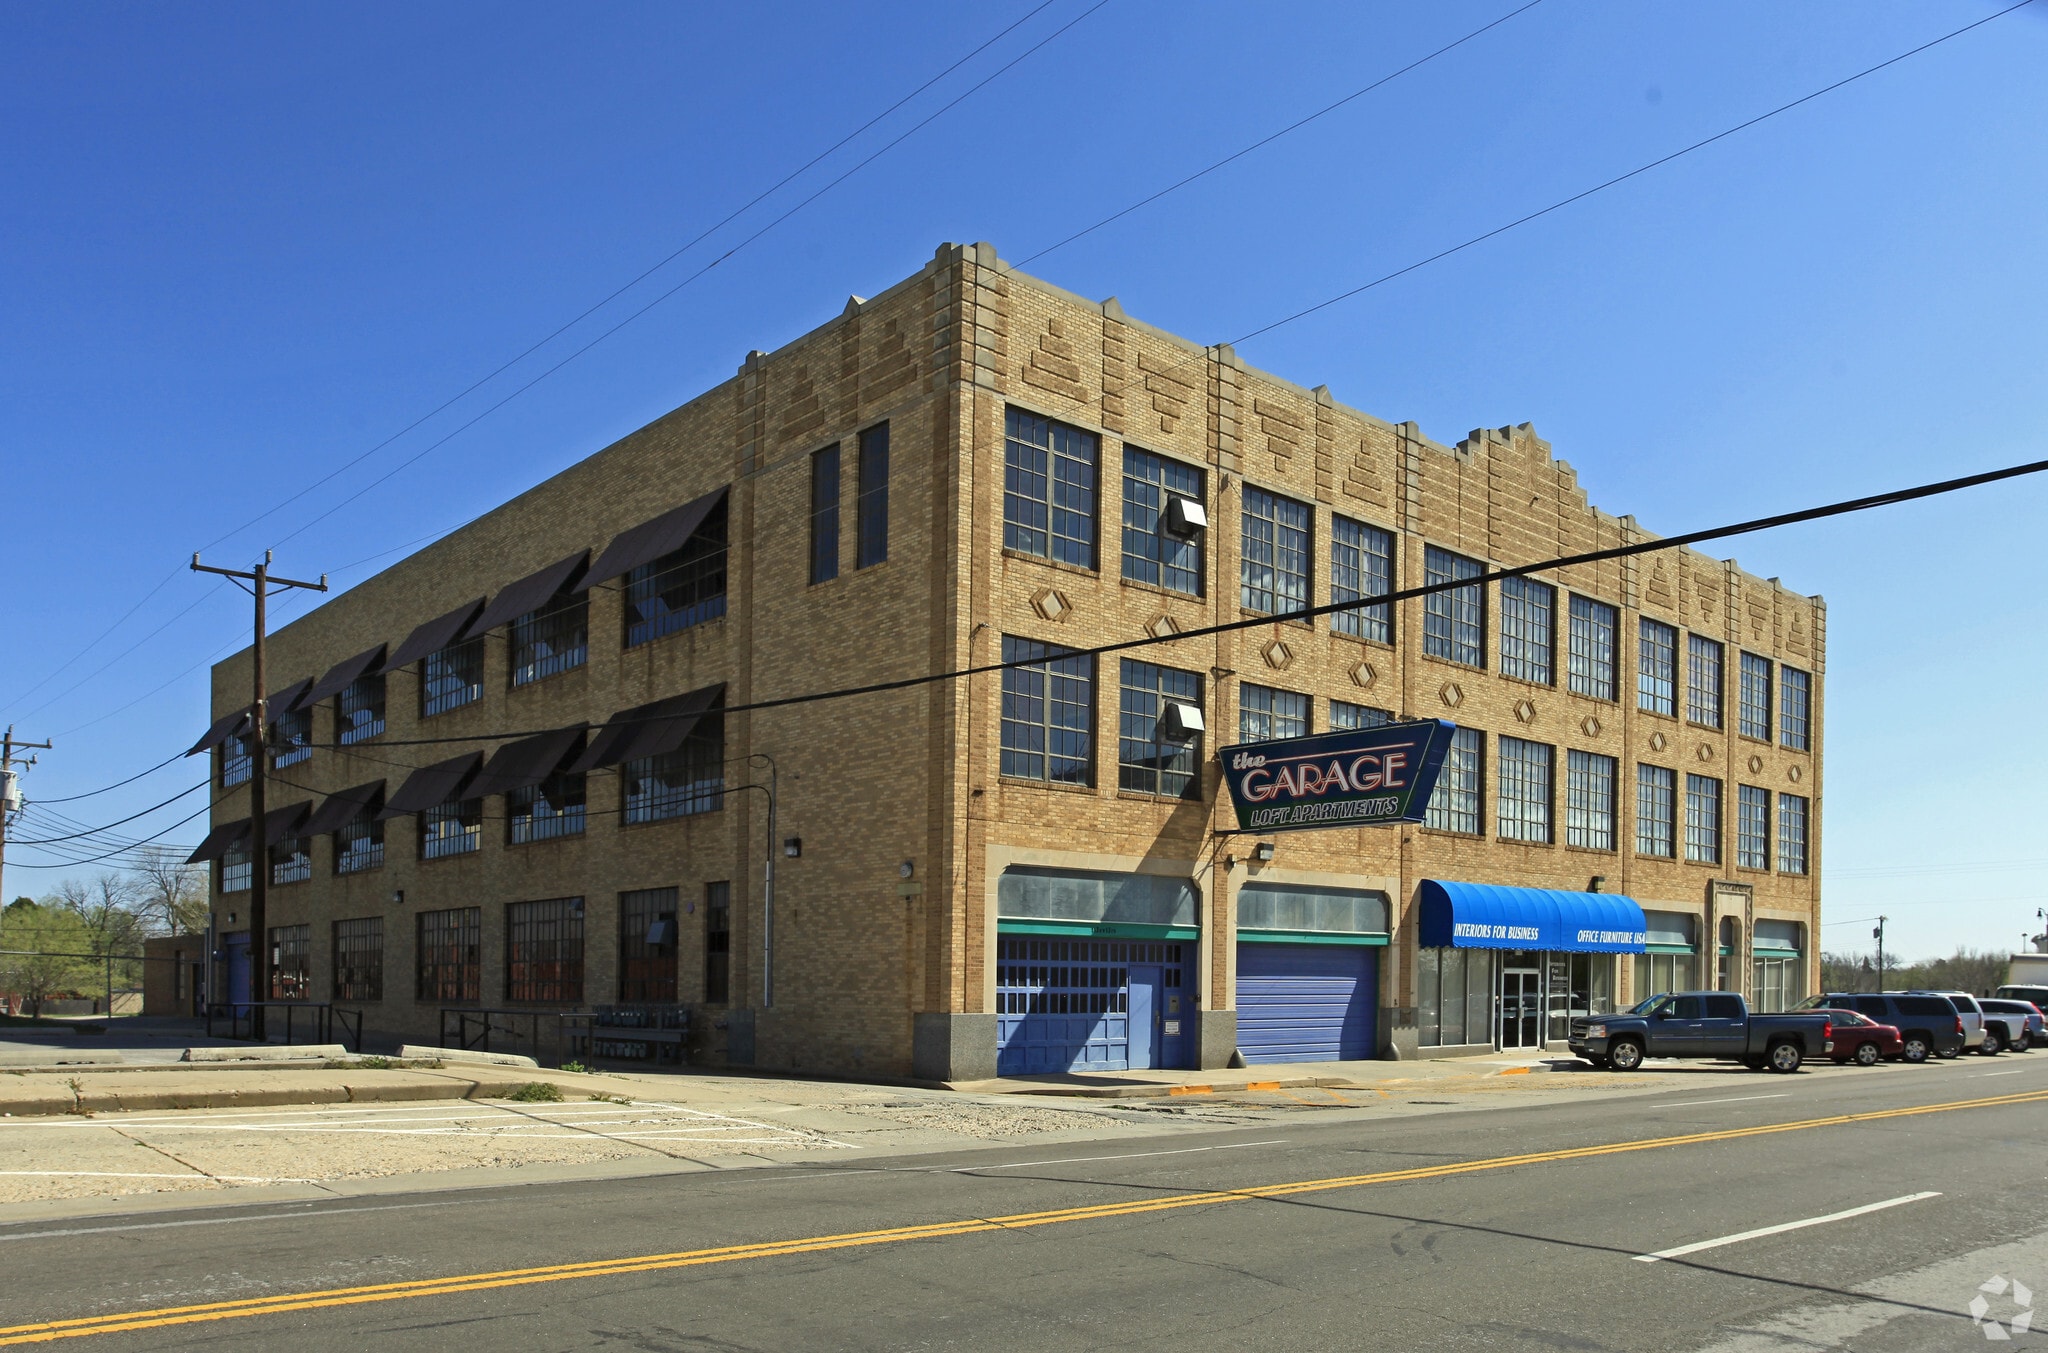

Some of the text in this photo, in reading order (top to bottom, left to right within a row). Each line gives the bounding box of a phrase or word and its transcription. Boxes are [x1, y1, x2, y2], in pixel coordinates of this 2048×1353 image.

[1232, 752, 1266, 770] the
[1240, 752, 1407, 802] GARAGE
[1250, 796, 1399, 827] LOFT APARTMENTS
[1454, 923, 1539, 941] INTERIORS FOR BUSINESS
[1577, 929, 1646, 945] OFFICE FURNITURE USA
